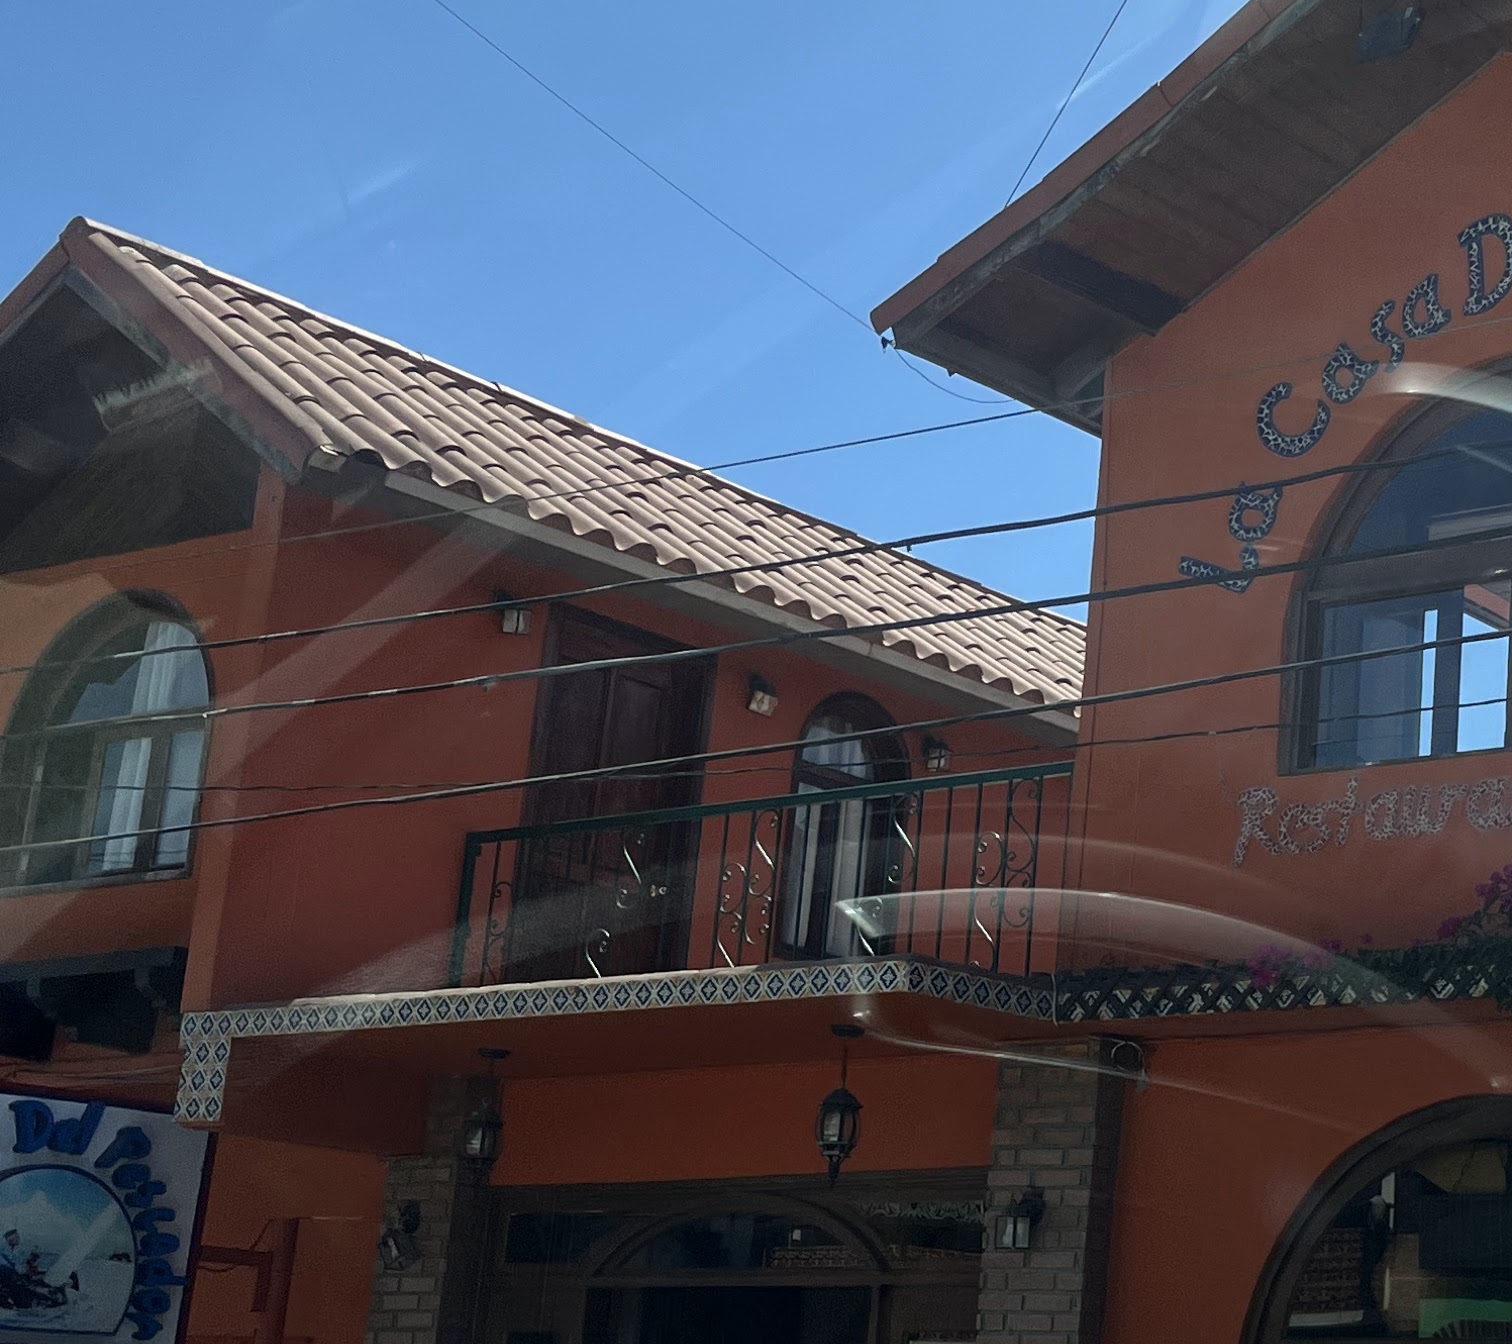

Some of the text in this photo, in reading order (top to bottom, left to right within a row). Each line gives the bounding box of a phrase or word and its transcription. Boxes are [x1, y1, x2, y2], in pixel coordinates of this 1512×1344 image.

[1178, 482, 1284, 593] La
[1256, 273, 1452, 458] Casa
[8, 1100, 188, 1341] Del Pescador
